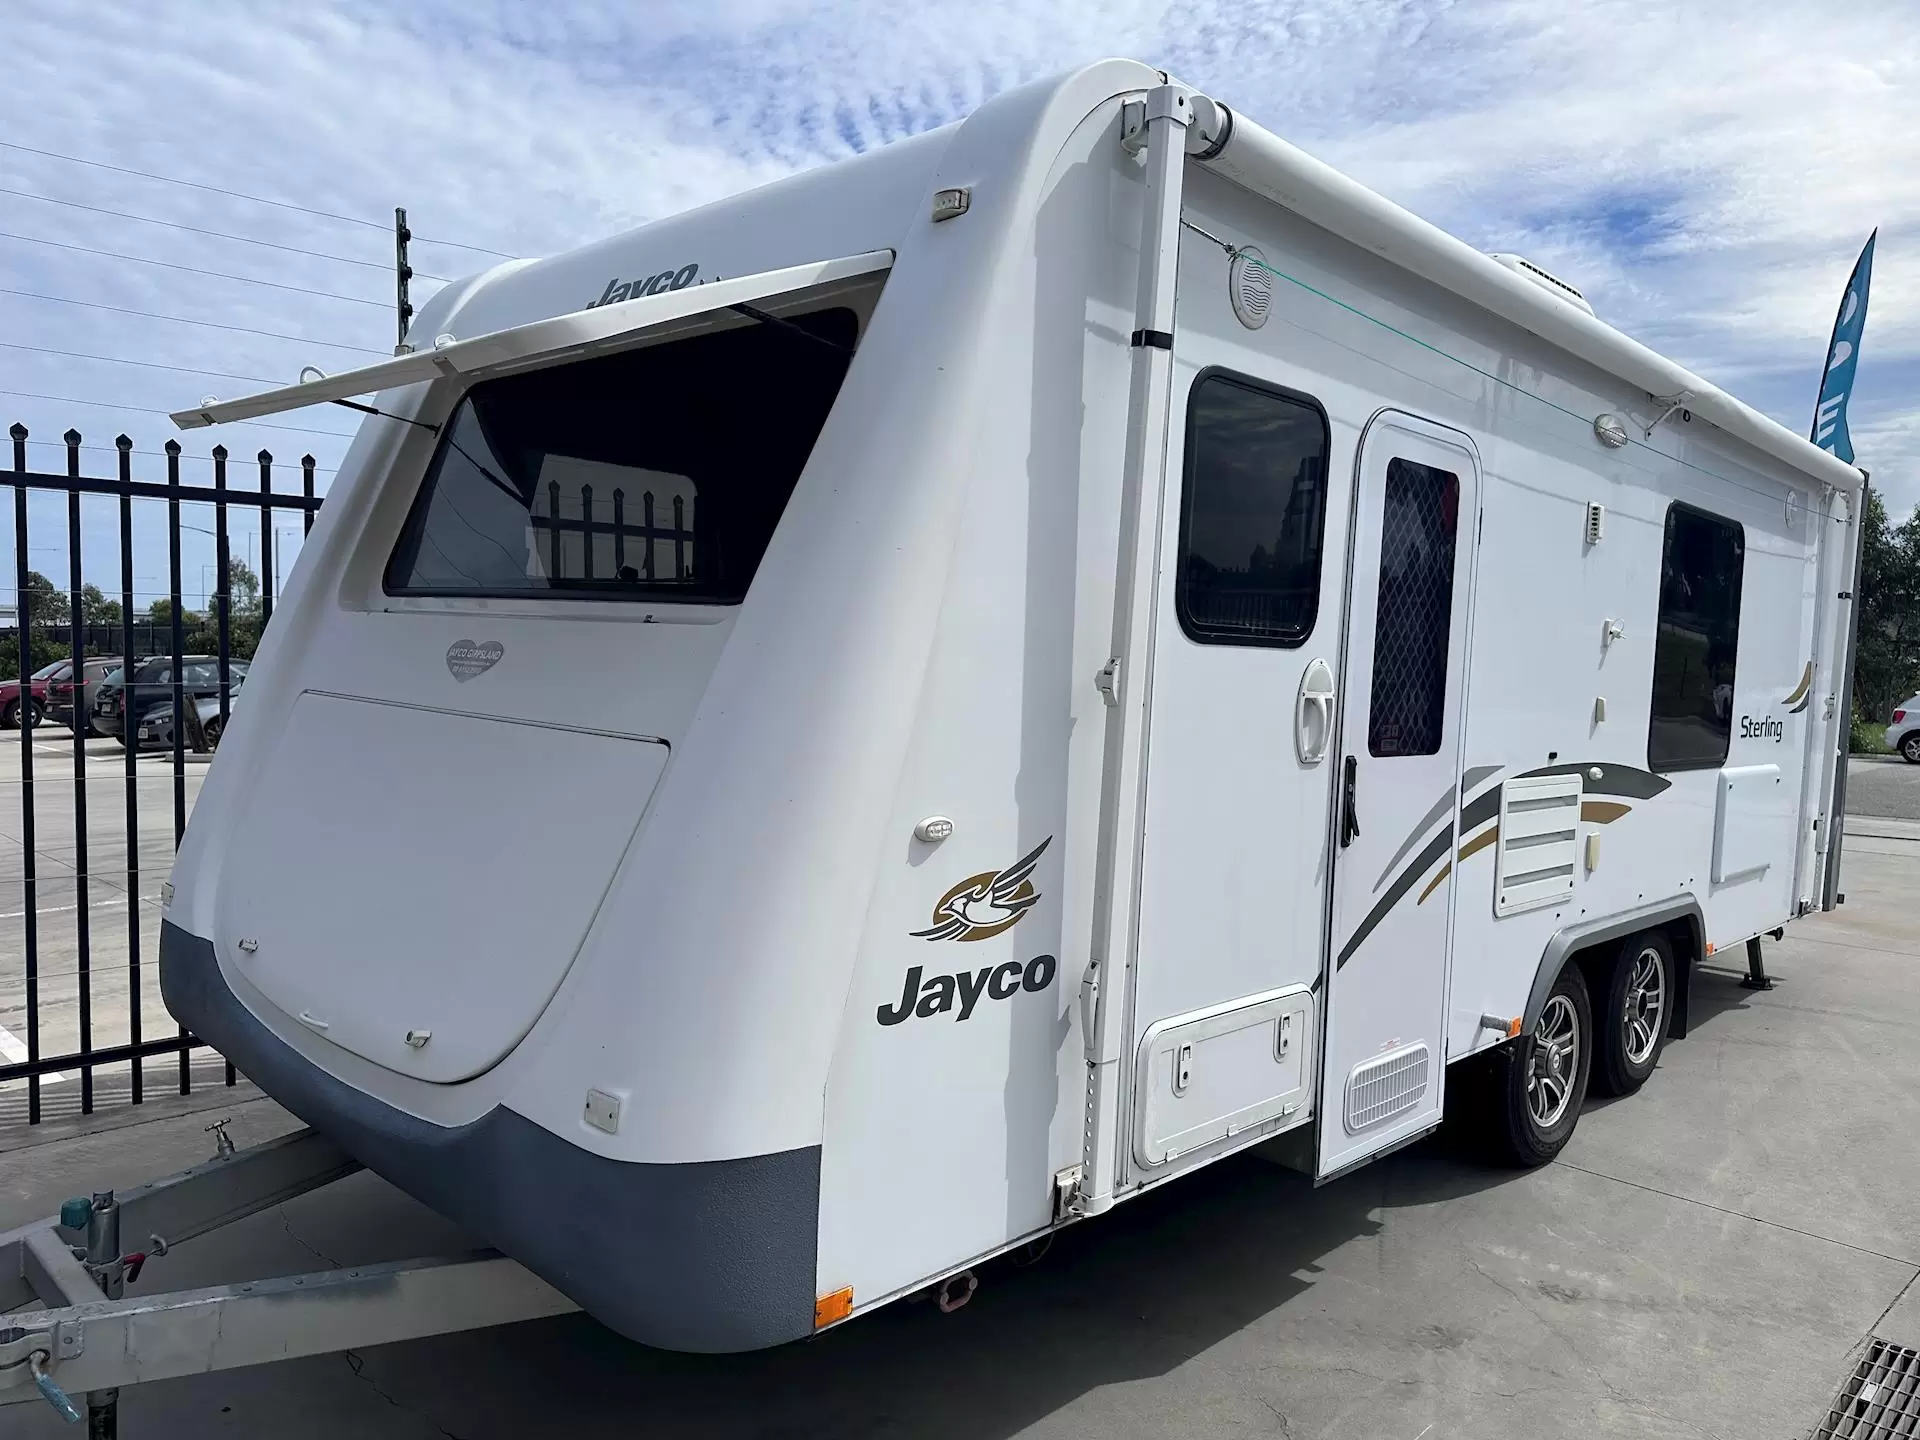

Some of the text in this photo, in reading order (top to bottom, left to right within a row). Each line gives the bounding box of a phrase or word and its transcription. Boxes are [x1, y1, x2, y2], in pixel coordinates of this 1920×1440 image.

[586, 263, 699, 310] Jayco
[448, 646, 502, 660] JAYCO GIPPSLAND
[1740, 715, 1783, 743] Sterling
[876, 954, 1057, 1026] Jayco
